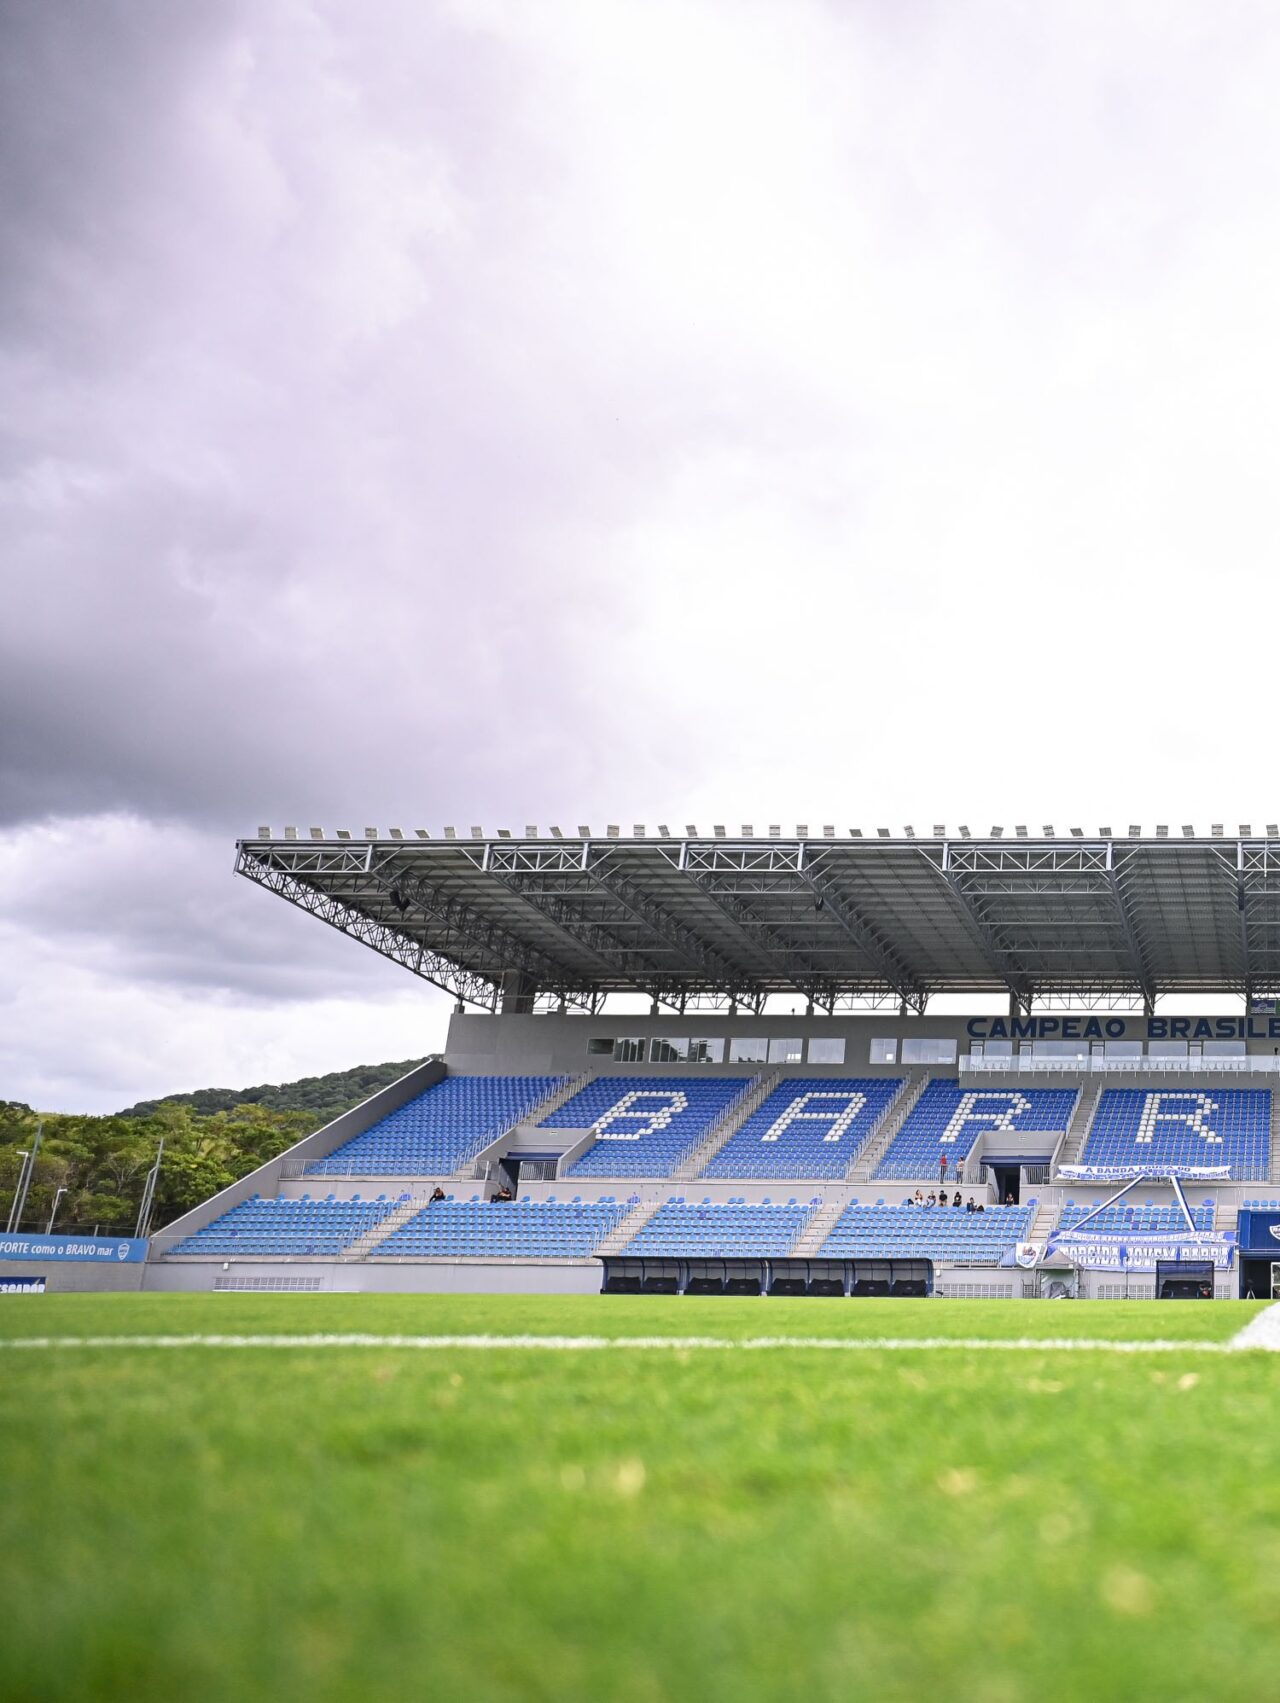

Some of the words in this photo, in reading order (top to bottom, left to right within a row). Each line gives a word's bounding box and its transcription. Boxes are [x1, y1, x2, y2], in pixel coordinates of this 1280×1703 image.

[0, 1242, 30, 1254] FORTE
[31, 1244, 56, 1255] como
[57, 1245, 64, 1255] o
[65, 1244, 96, 1256] BRAVO
[97, 1247, 114, 1256] mar
